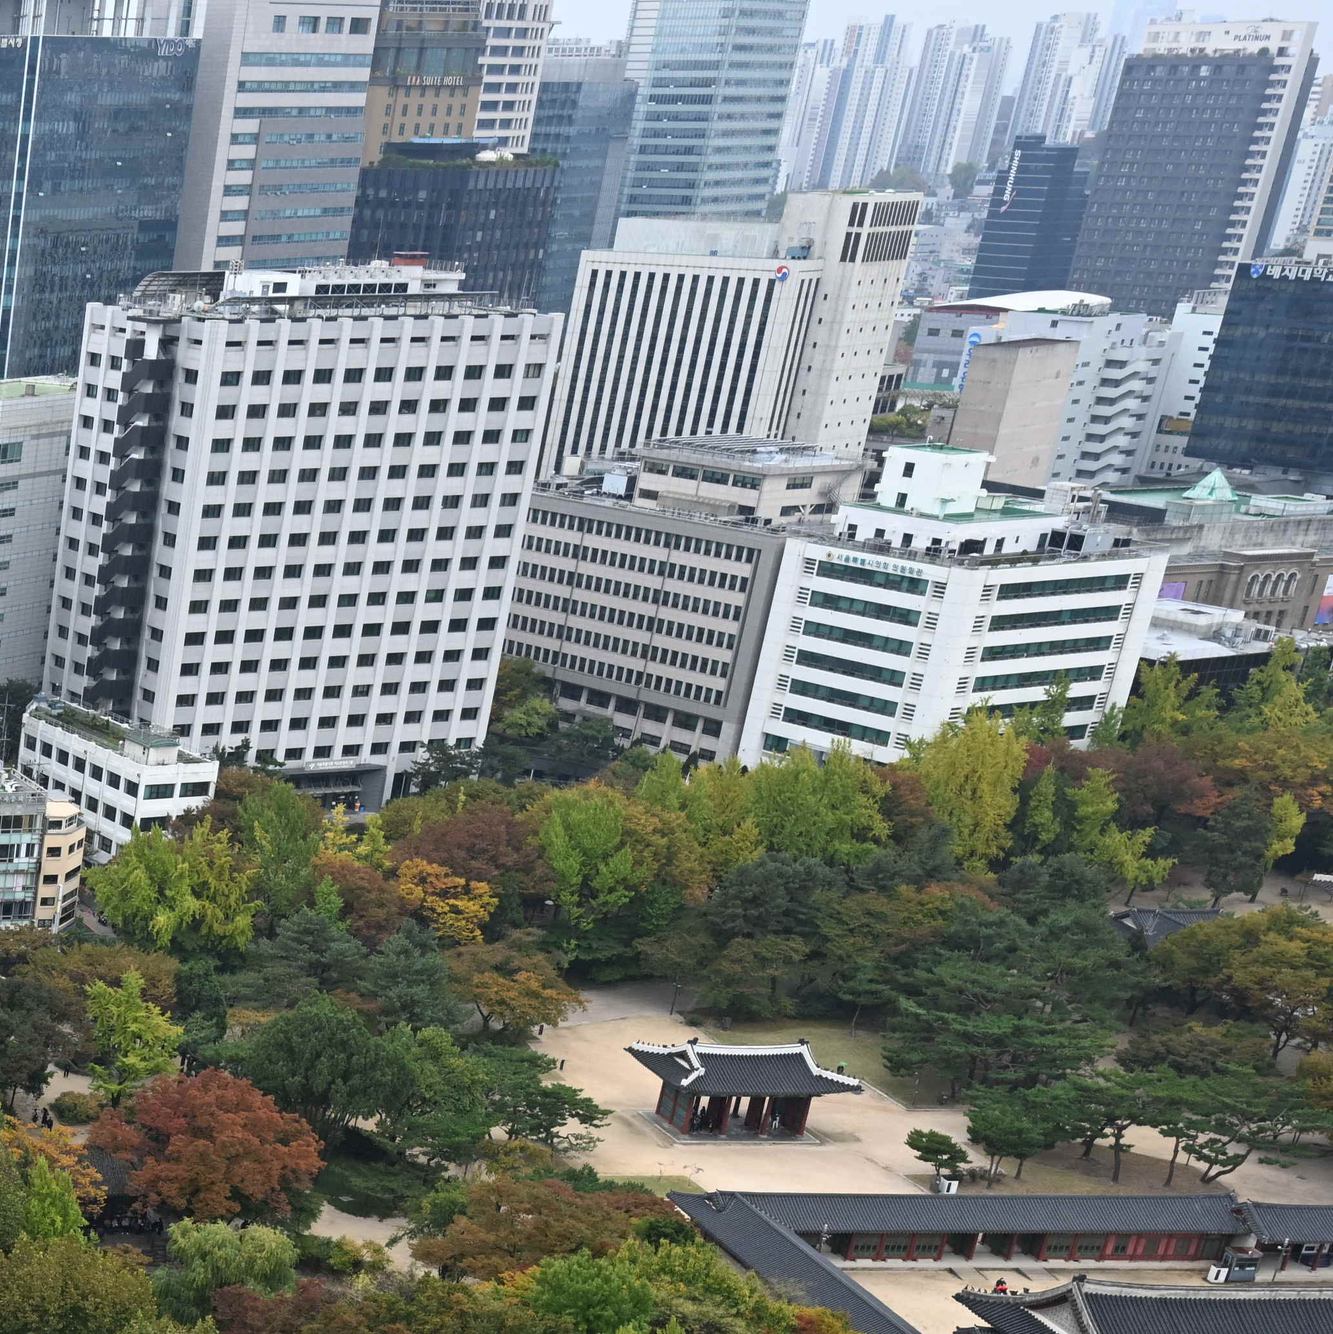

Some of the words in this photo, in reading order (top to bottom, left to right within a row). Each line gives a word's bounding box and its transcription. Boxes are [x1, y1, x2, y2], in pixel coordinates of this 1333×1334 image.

[1233, 33, 1271, 42] PLATINUM
[422, 75, 441, 86] SUITE
[443, 75, 464, 86] HOTEL
[1002, 149, 1021, 201] SHINHUNG
